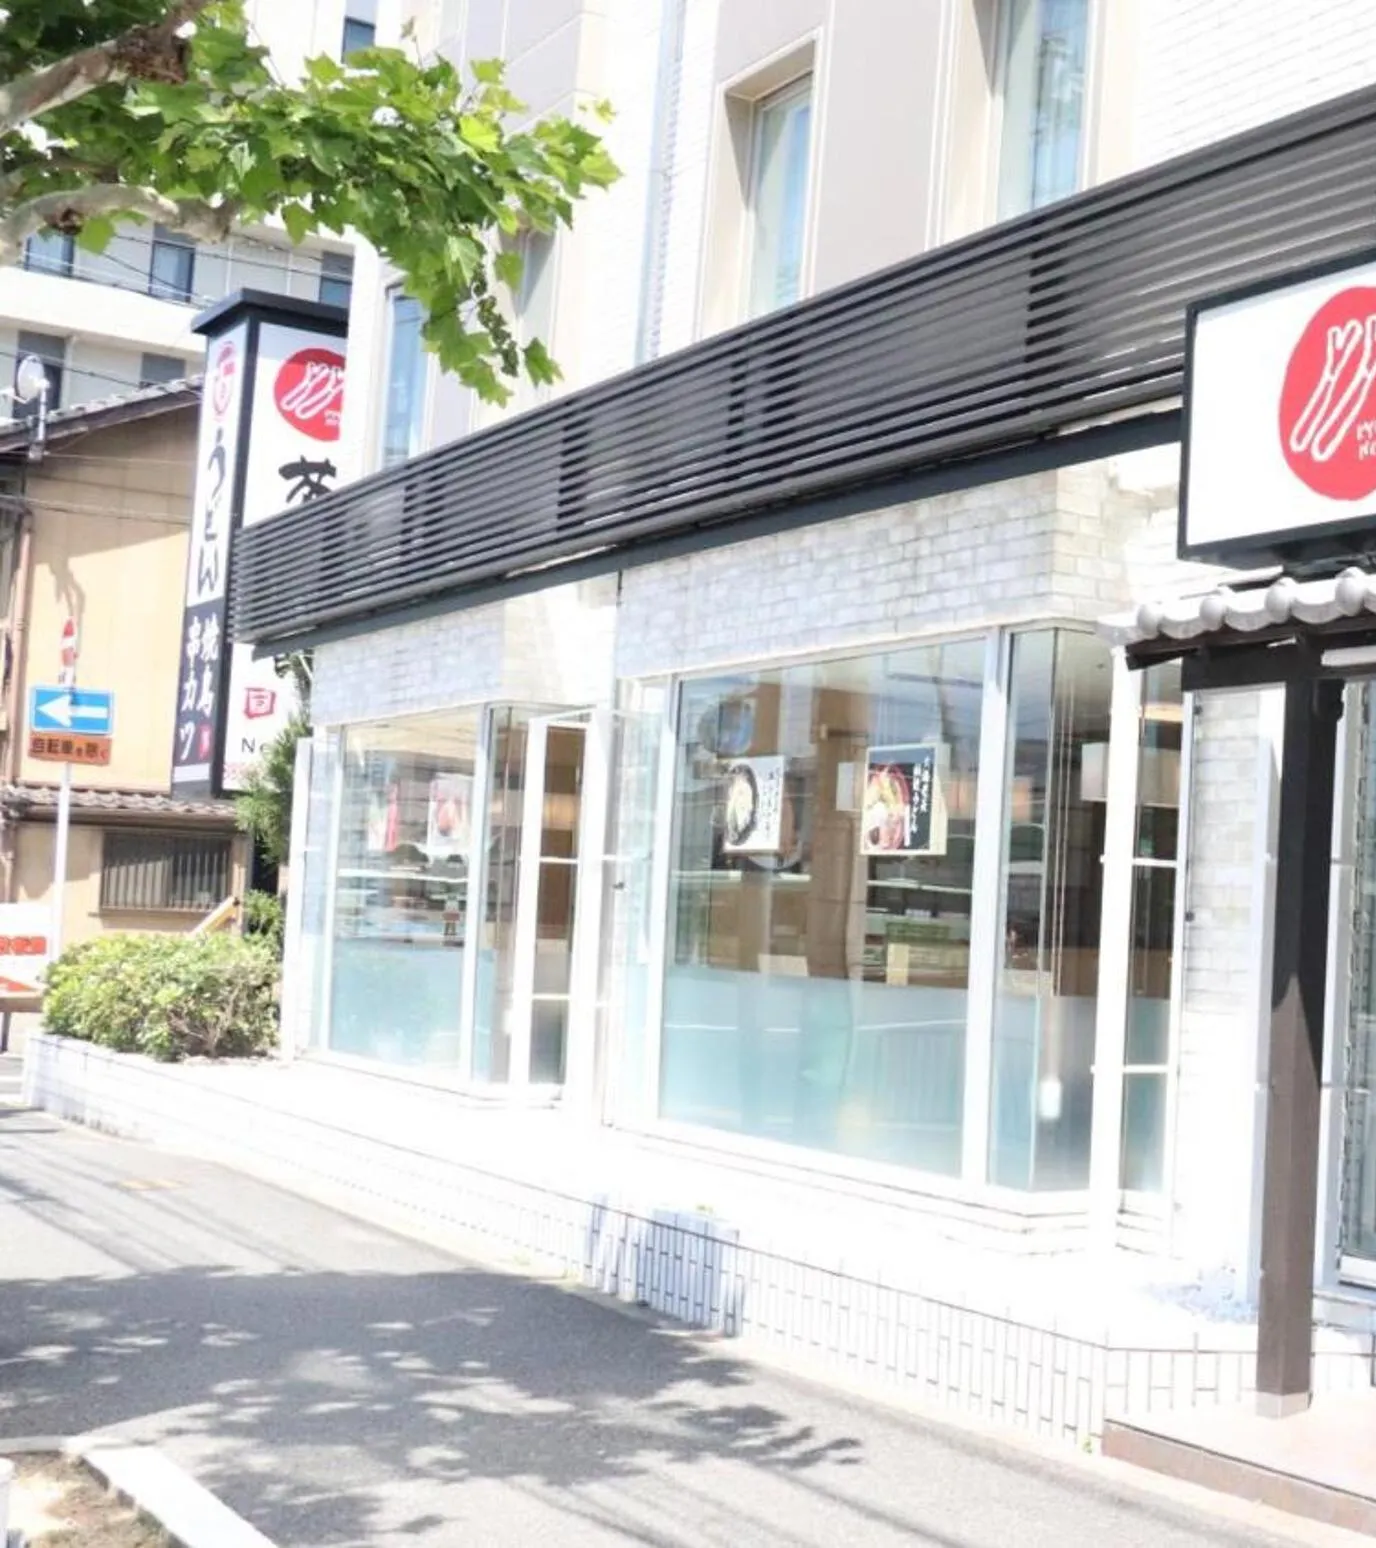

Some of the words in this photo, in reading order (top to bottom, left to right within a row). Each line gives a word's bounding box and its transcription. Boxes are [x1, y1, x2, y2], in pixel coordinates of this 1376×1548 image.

[197, 427, 227, 597] うどん
[179, 614, 202, 761] 串カツ
